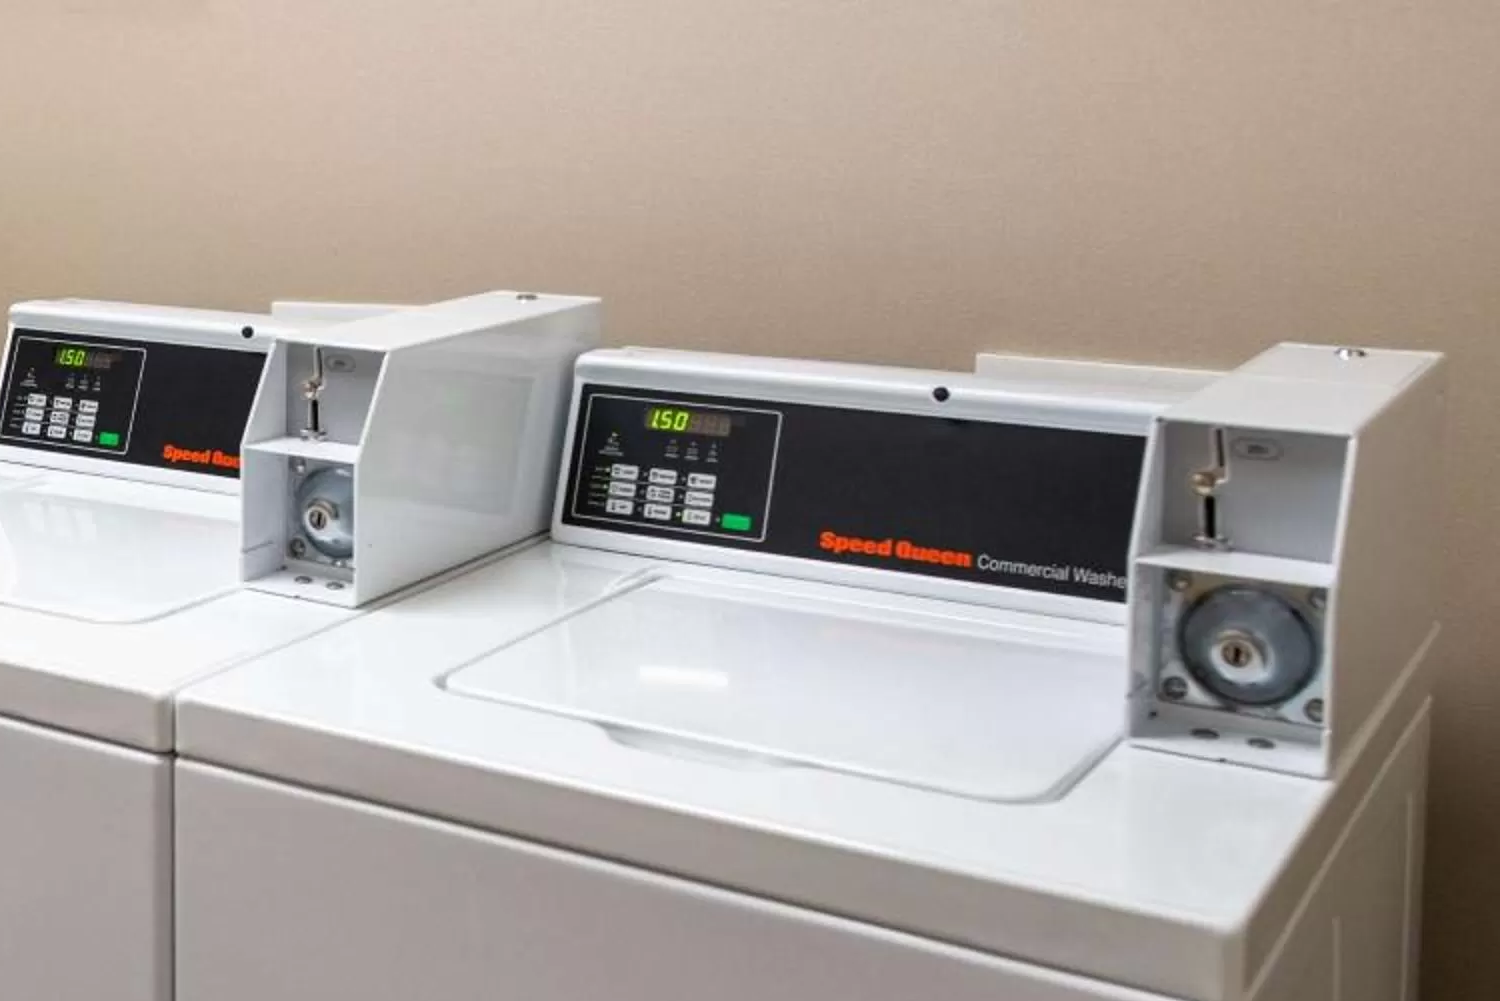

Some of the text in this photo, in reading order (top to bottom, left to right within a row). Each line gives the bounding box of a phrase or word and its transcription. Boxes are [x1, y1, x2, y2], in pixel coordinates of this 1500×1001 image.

[163, 443, 242, 469] Speed Que
[819, 531, 1126, 589] Speed Queen Commercial Washe
